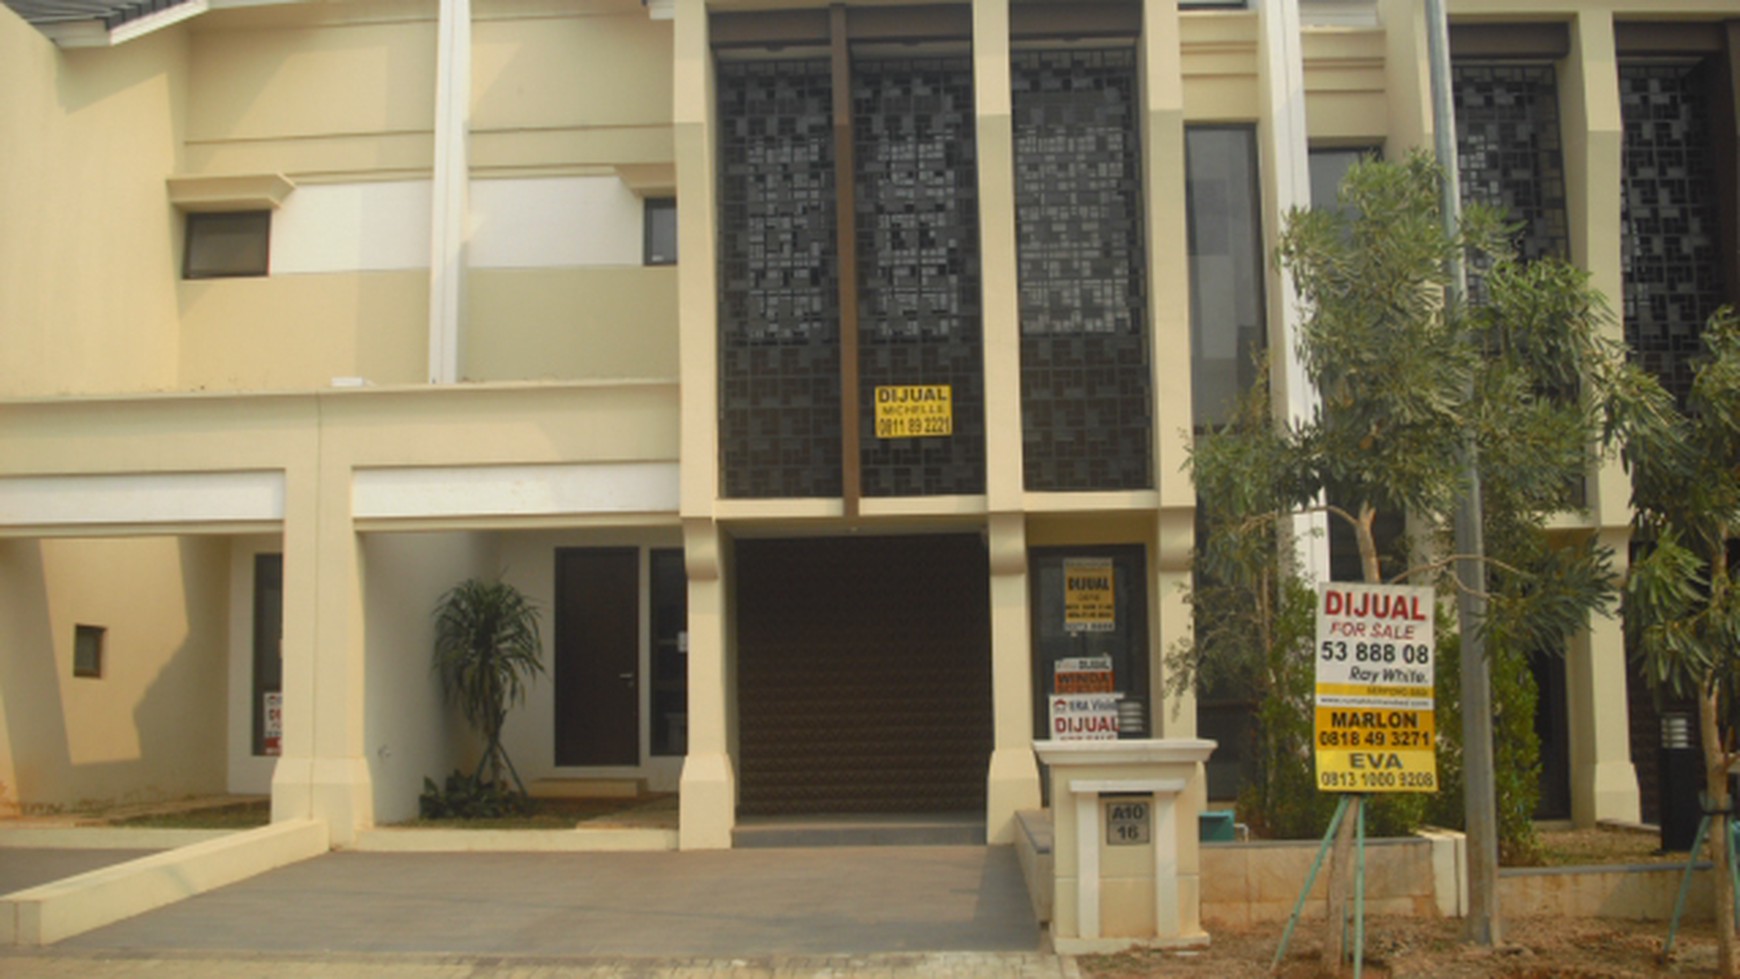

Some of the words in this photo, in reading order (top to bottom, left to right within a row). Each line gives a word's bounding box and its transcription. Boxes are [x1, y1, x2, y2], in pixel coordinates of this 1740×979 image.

[878, 388, 947, 403] DIJUAL
[880, 418, 904, 436] 0811
[924, 416, 951, 433] 2221
[1068, 577, 1110, 590] DIJUAL
[1325, 590, 1426, 621] DIJUAL
[1329, 622, 1366, 637] FOR
[1370, 623, 1415, 639] SALE
[1321, 641, 1348, 661] 53
[1355, 642, 1396, 662] 888
[1402, 644, 1429, 664] 08
[1348, 666, 1379, 684] Ray
[1070, 700, 1088, 711] ERA
[1055, 717, 1120, 733] DIJUAL
[1331, 711, 1418, 728] MARLON
[1320, 731, 1360, 746] 0818
[1365, 731, 1385, 746] 49
[1391, 731, 1430, 746] 3271
[1349, 753, 1403, 769] EVA
[1321, 771, 1357, 786] 0813
[1112, 804, 1144, 820] A10
[1117, 825, 1139, 840] 16
